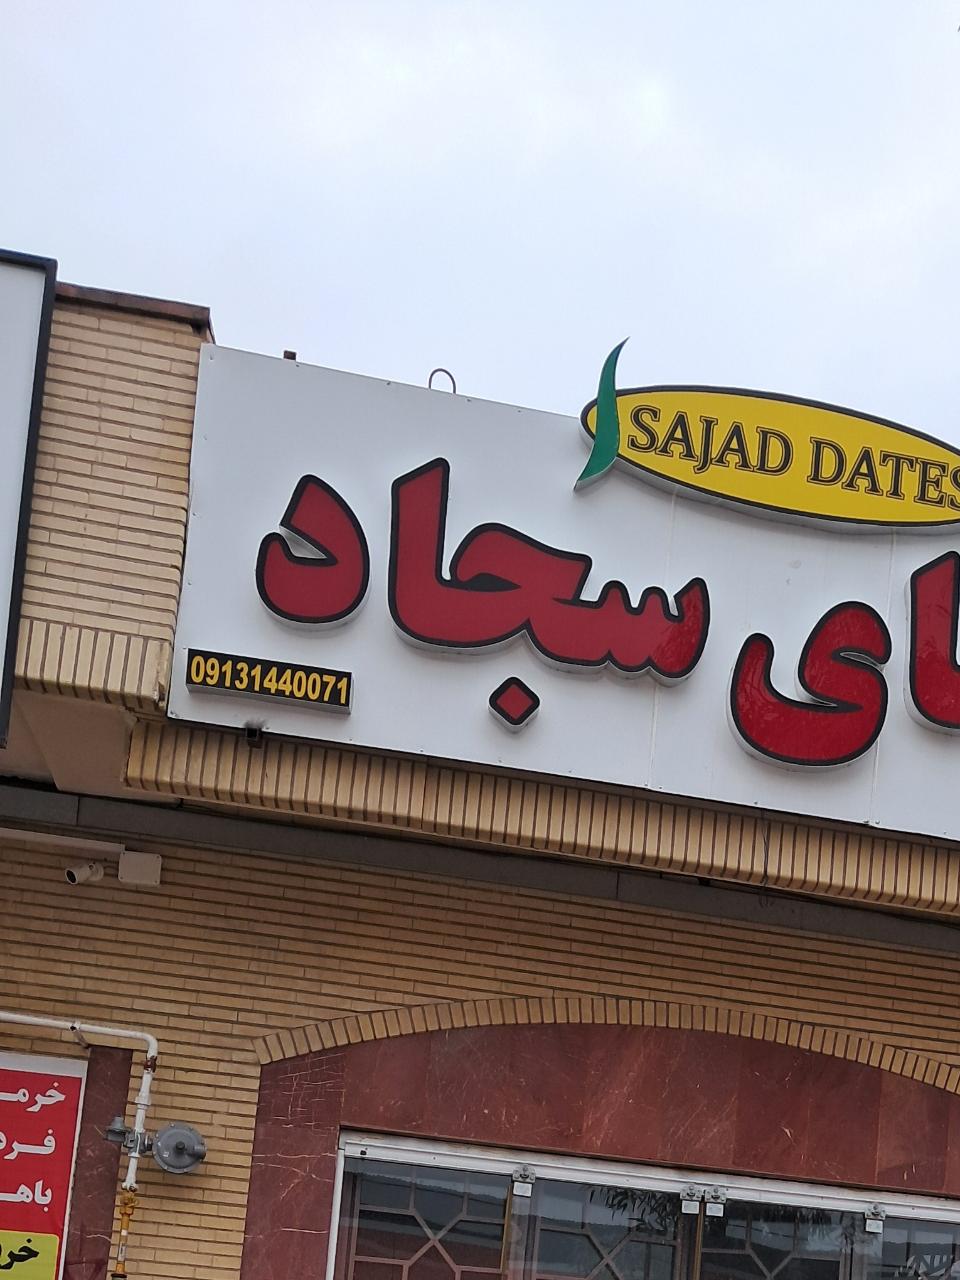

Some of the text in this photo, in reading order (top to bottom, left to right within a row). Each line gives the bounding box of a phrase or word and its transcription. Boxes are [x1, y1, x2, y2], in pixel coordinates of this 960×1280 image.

[627, 404, 793, 475] SAJAD
[256, 457, 710, 726] سجاد
[190, 655, 348, 704] 09131440071
[0, 1238, 40, 1270] خر
